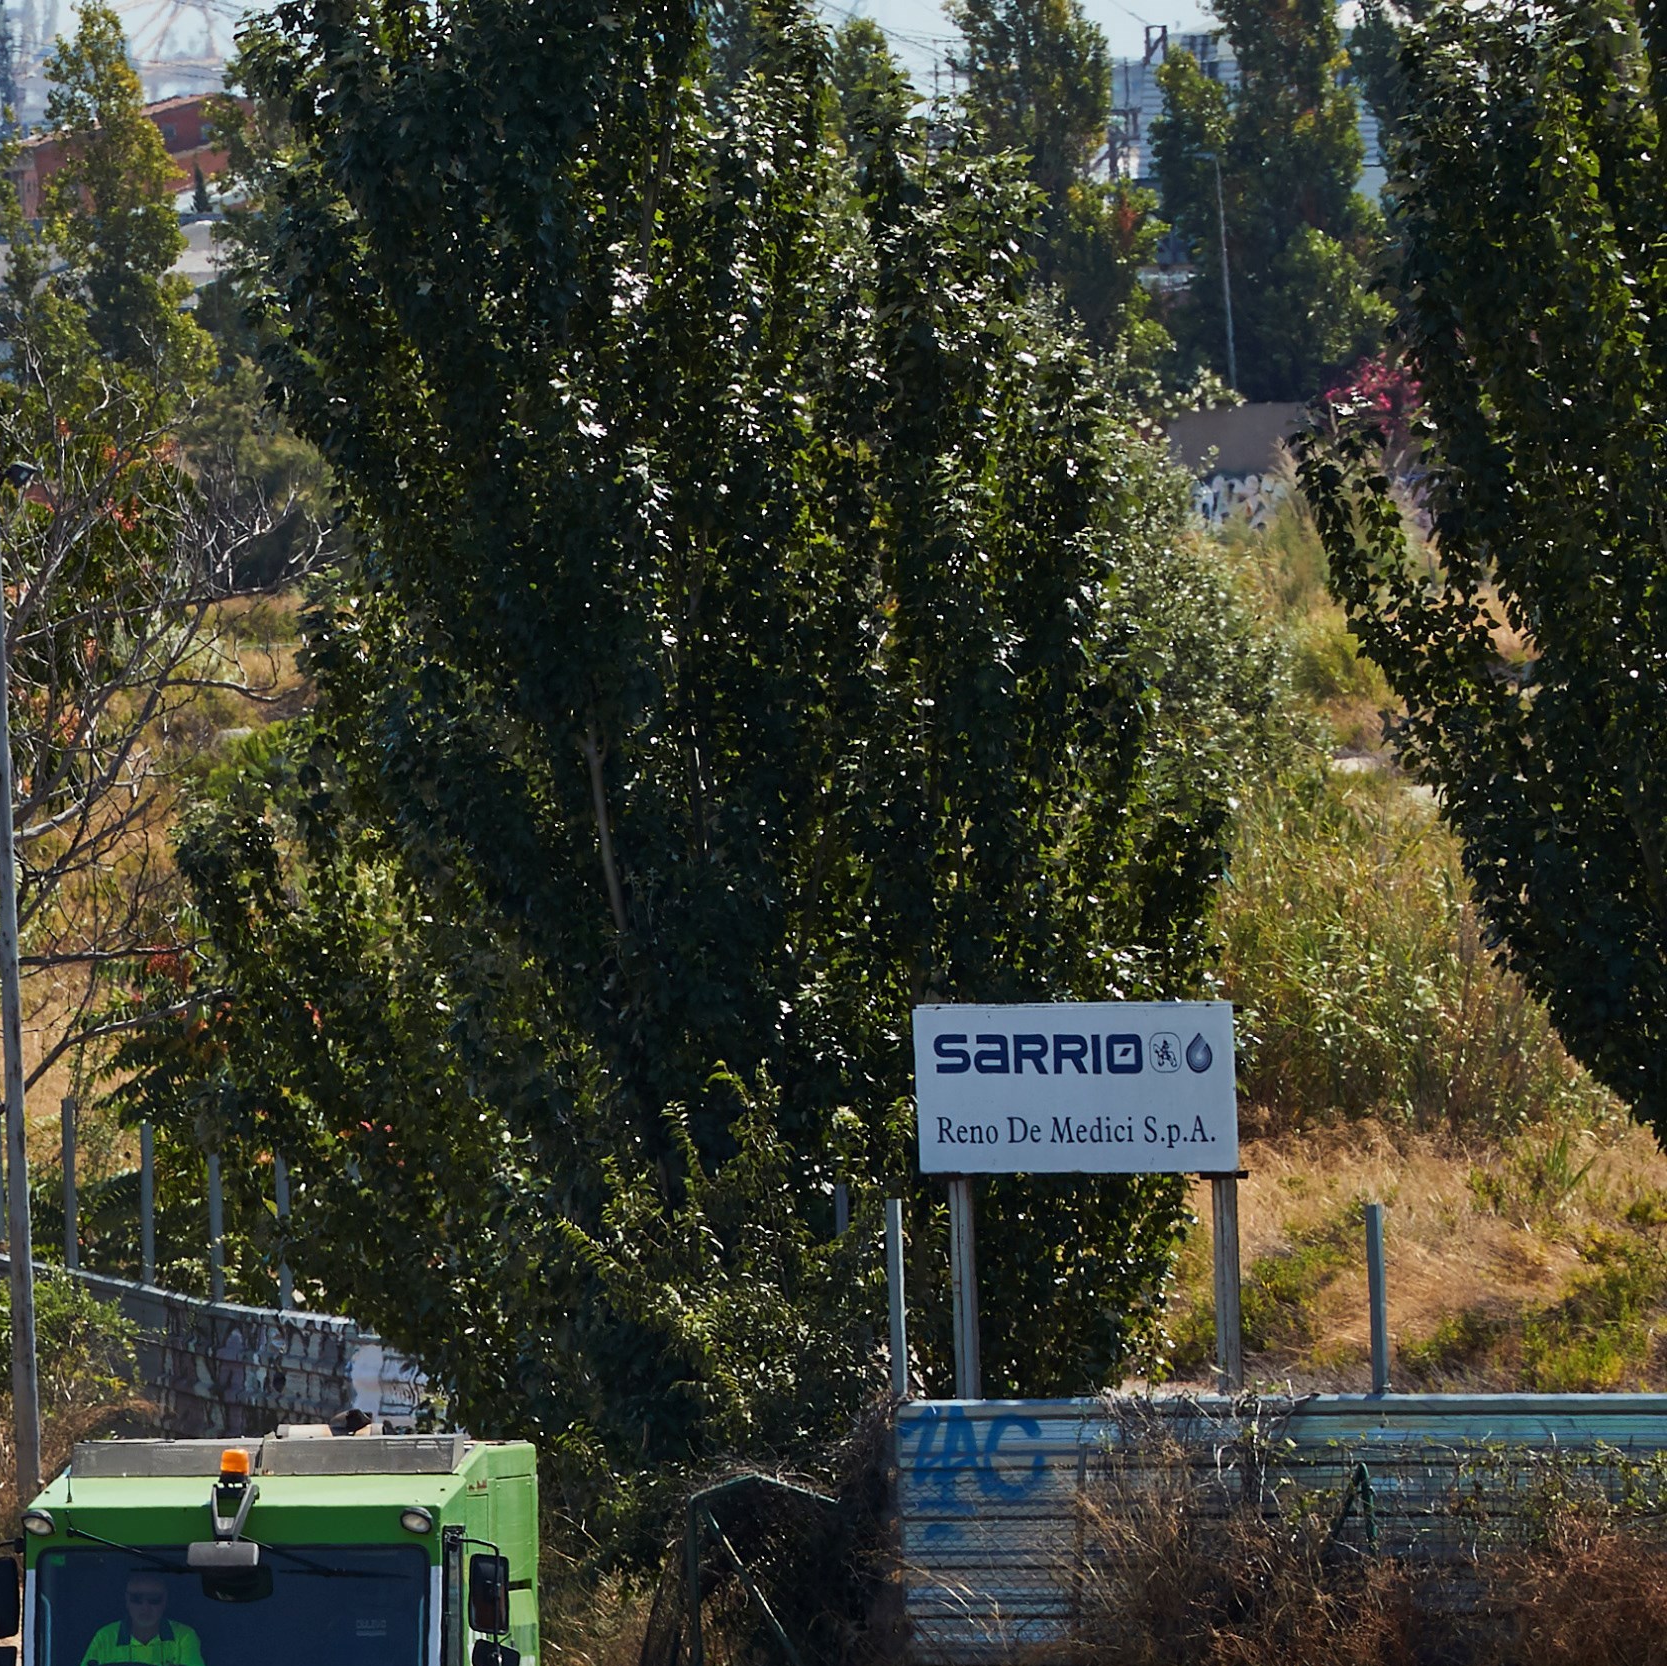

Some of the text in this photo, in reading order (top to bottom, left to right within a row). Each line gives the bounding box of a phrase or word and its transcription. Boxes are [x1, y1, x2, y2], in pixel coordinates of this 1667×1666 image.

[937, 1115, 1216, 1148] Reno De Medici S.p.A.
